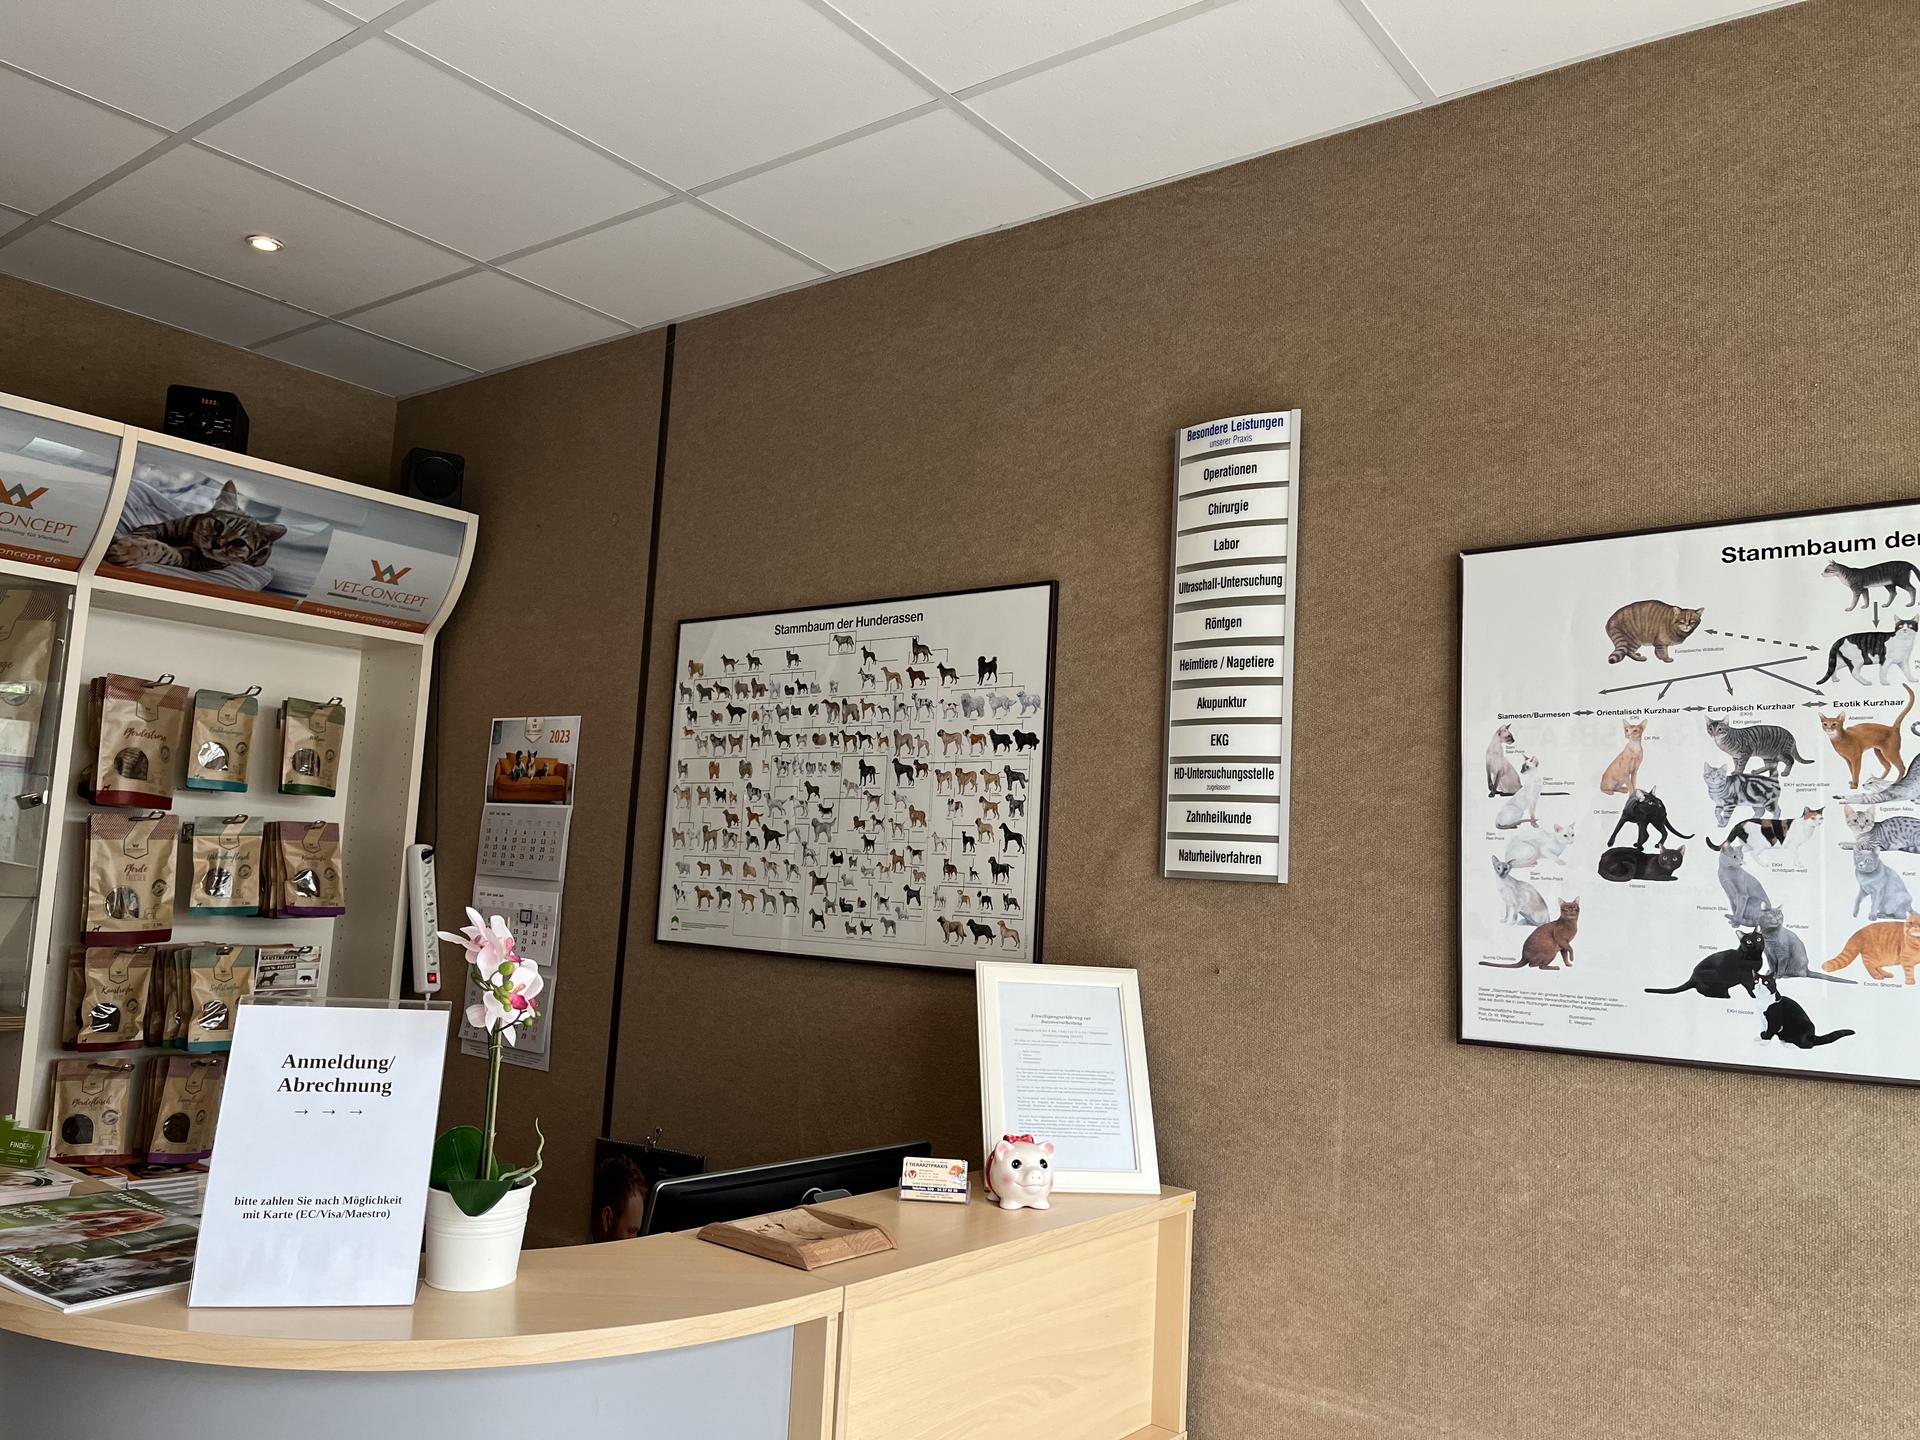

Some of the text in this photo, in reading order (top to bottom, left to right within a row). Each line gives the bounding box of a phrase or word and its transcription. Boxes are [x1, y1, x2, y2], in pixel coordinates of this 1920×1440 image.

[1187, 416, 1284, 442] Besondere Leistungen
[1209, 434, 1253, 448] unserer Praxis
[1203, 463, 1257, 482] Operationen
[1208, 500, 1248, 516] Chirurgie
[1214, 538, 1240, 552] Labor
[1721, 537, 1876, 563] Stammbaum
[1179, 573, 1283, 595] Ultraschall-Untersuchung
[334, 579, 429, 607] VET-CONCEPT
[774, 612, 924, 636] Stammbaum der Hunderassen
[1205, 615, 1242, 631] Röntgen
[1179, 658, 1218, 672] Heimtiere
[1226, 655, 1275, 671] Nagetiere
[1197, 696, 1247, 711] Akupunktur
[1707, 703, 1796, 713] Europäisch Kurzhaar
[1833, 698, 1904, 708] Exotik Kurzhaar
[1497, 711, 1571, 720] Siamesen/Burmesen
[1596, 707, 1680, 717] Orientalisch Kurzhaar
[549, 729, 571, 744] 2023
[1210, 733, 1229, 747] EKG
[1174, 766, 1275, 782] HD-Untersuchungsstelle
[1186, 810, 1252, 825] Zahnheilkunde
[1178, 849, 1262, 865] Naturheilverfahren
[281, 1053, 396, 1074] Anmeldung/
[277, 1077, 393, 1098] Abrechnung
[234, 1195, 403, 1207] bitte zahlen Sie nach Möglichkeit
[242, 1209, 391, 1220] mit Karte (EC/Visa/Maestro)
